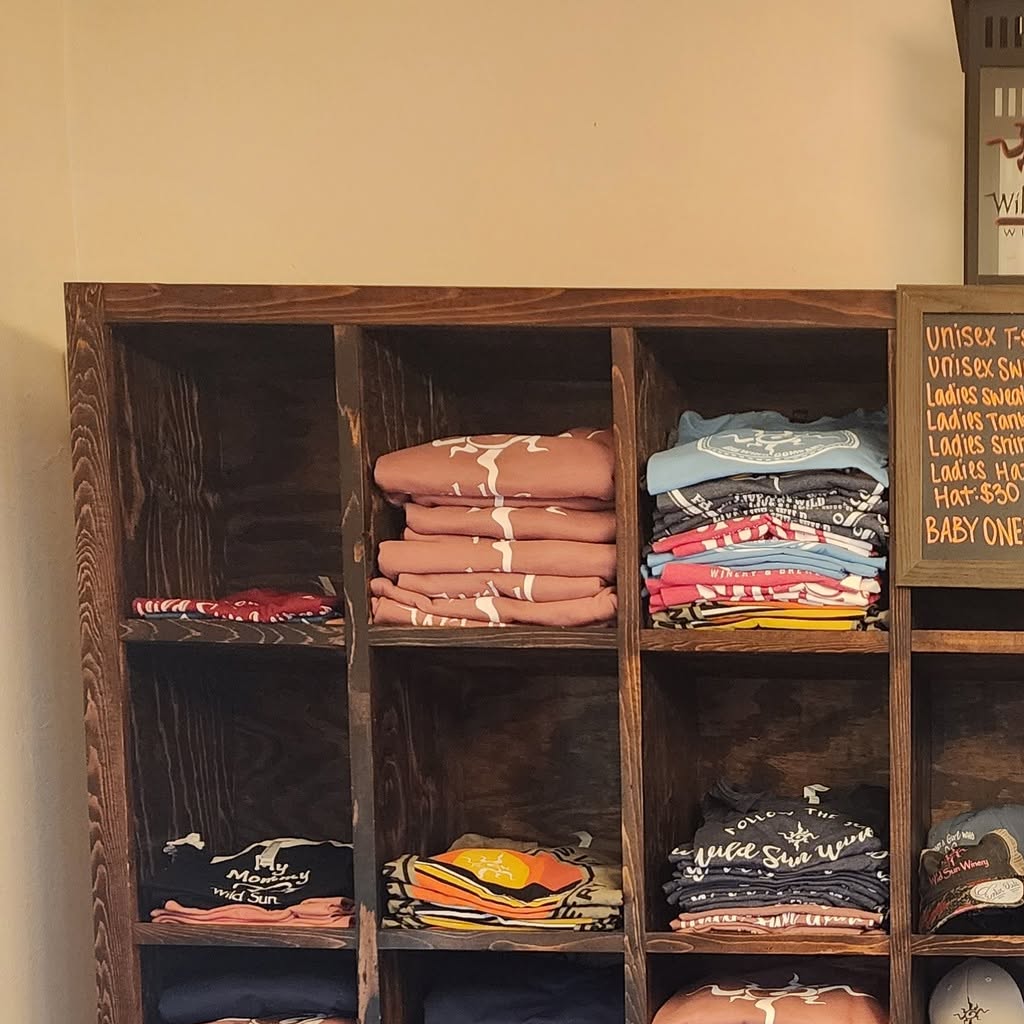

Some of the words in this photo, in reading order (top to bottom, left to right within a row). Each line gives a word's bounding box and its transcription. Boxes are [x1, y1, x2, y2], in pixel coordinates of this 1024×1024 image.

[926, 323, 997, 351] Unisex
[928, 353, 994, 378] Unisex
[926, 382, 978, 406] Ladies
[926, 407, 984, 431] Ladies
[928, 432, 985, 457] Ladies
[930, 458, 987, 483] Ladies
[925, 516, 979, 544] BABY
[943, 866, 960, 880] Sun
[960, 859, 989, 872] Winery
[247, 892, 281, 904] Sun
